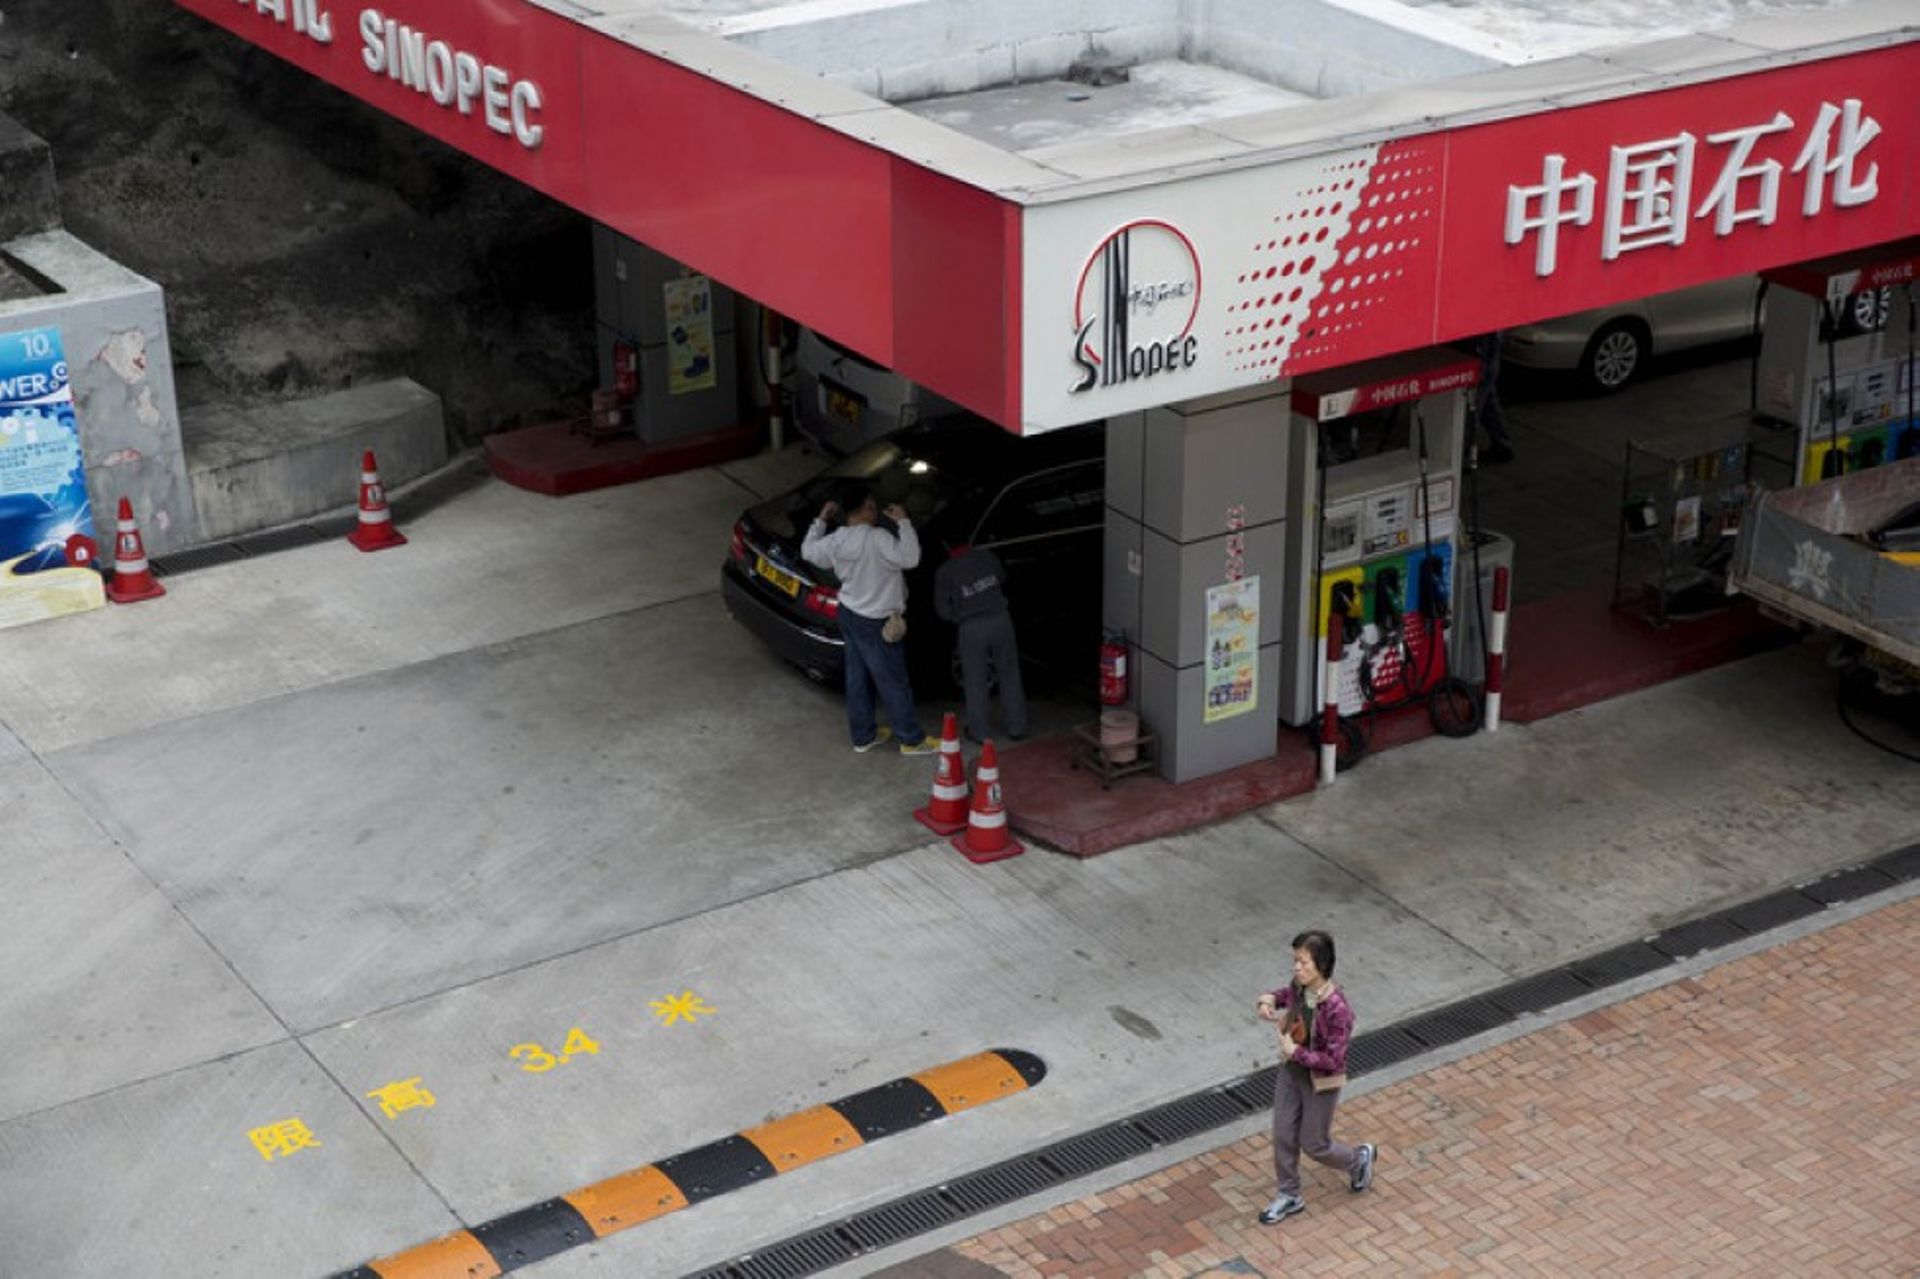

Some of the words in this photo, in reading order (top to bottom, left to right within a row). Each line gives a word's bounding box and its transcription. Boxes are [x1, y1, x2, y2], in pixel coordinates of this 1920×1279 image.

[359, 9, 543, 147] SINOPEC
[1504, 98, 1882, 277] 中国石化
[20, 333, 49, 358] 10
[509, 1027, 601, 1073] 3.4
[648, 990, 718, 1027] 米
